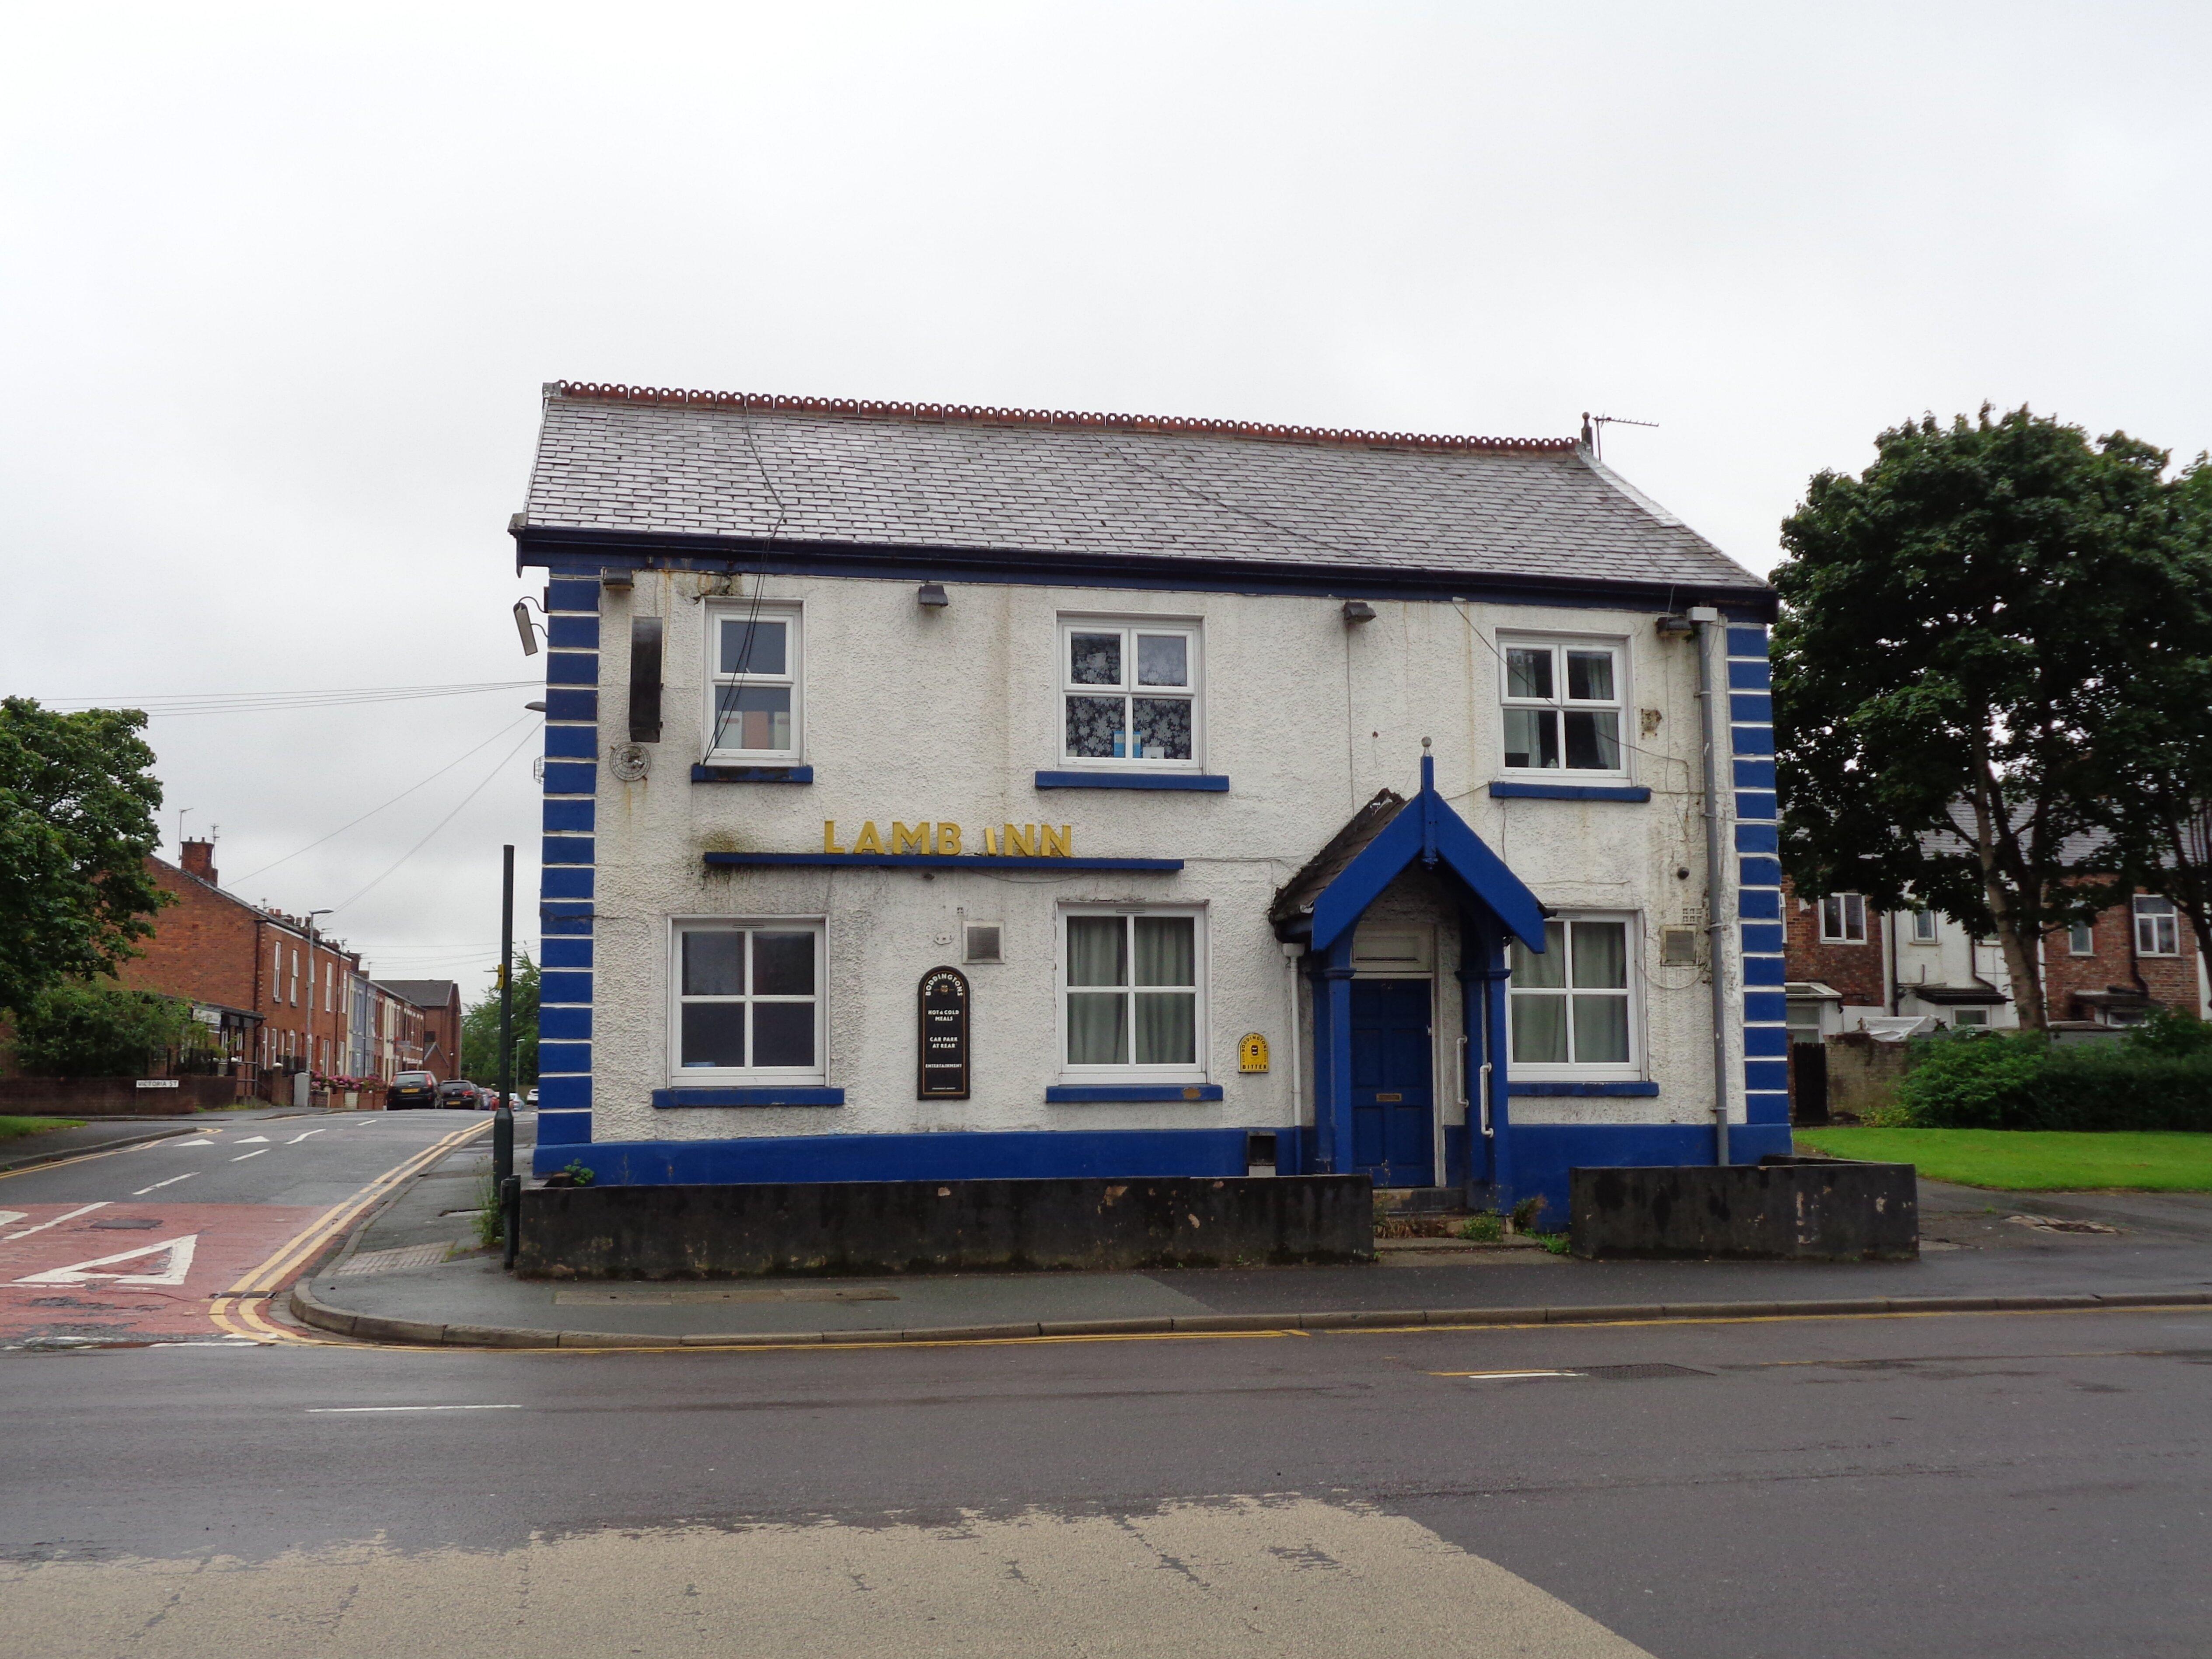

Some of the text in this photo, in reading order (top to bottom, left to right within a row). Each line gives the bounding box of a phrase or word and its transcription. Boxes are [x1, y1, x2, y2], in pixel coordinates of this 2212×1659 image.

[824, 820, 1071, 857] LAMB INN
[925, 973, 963, 996] BODDINGTONS
